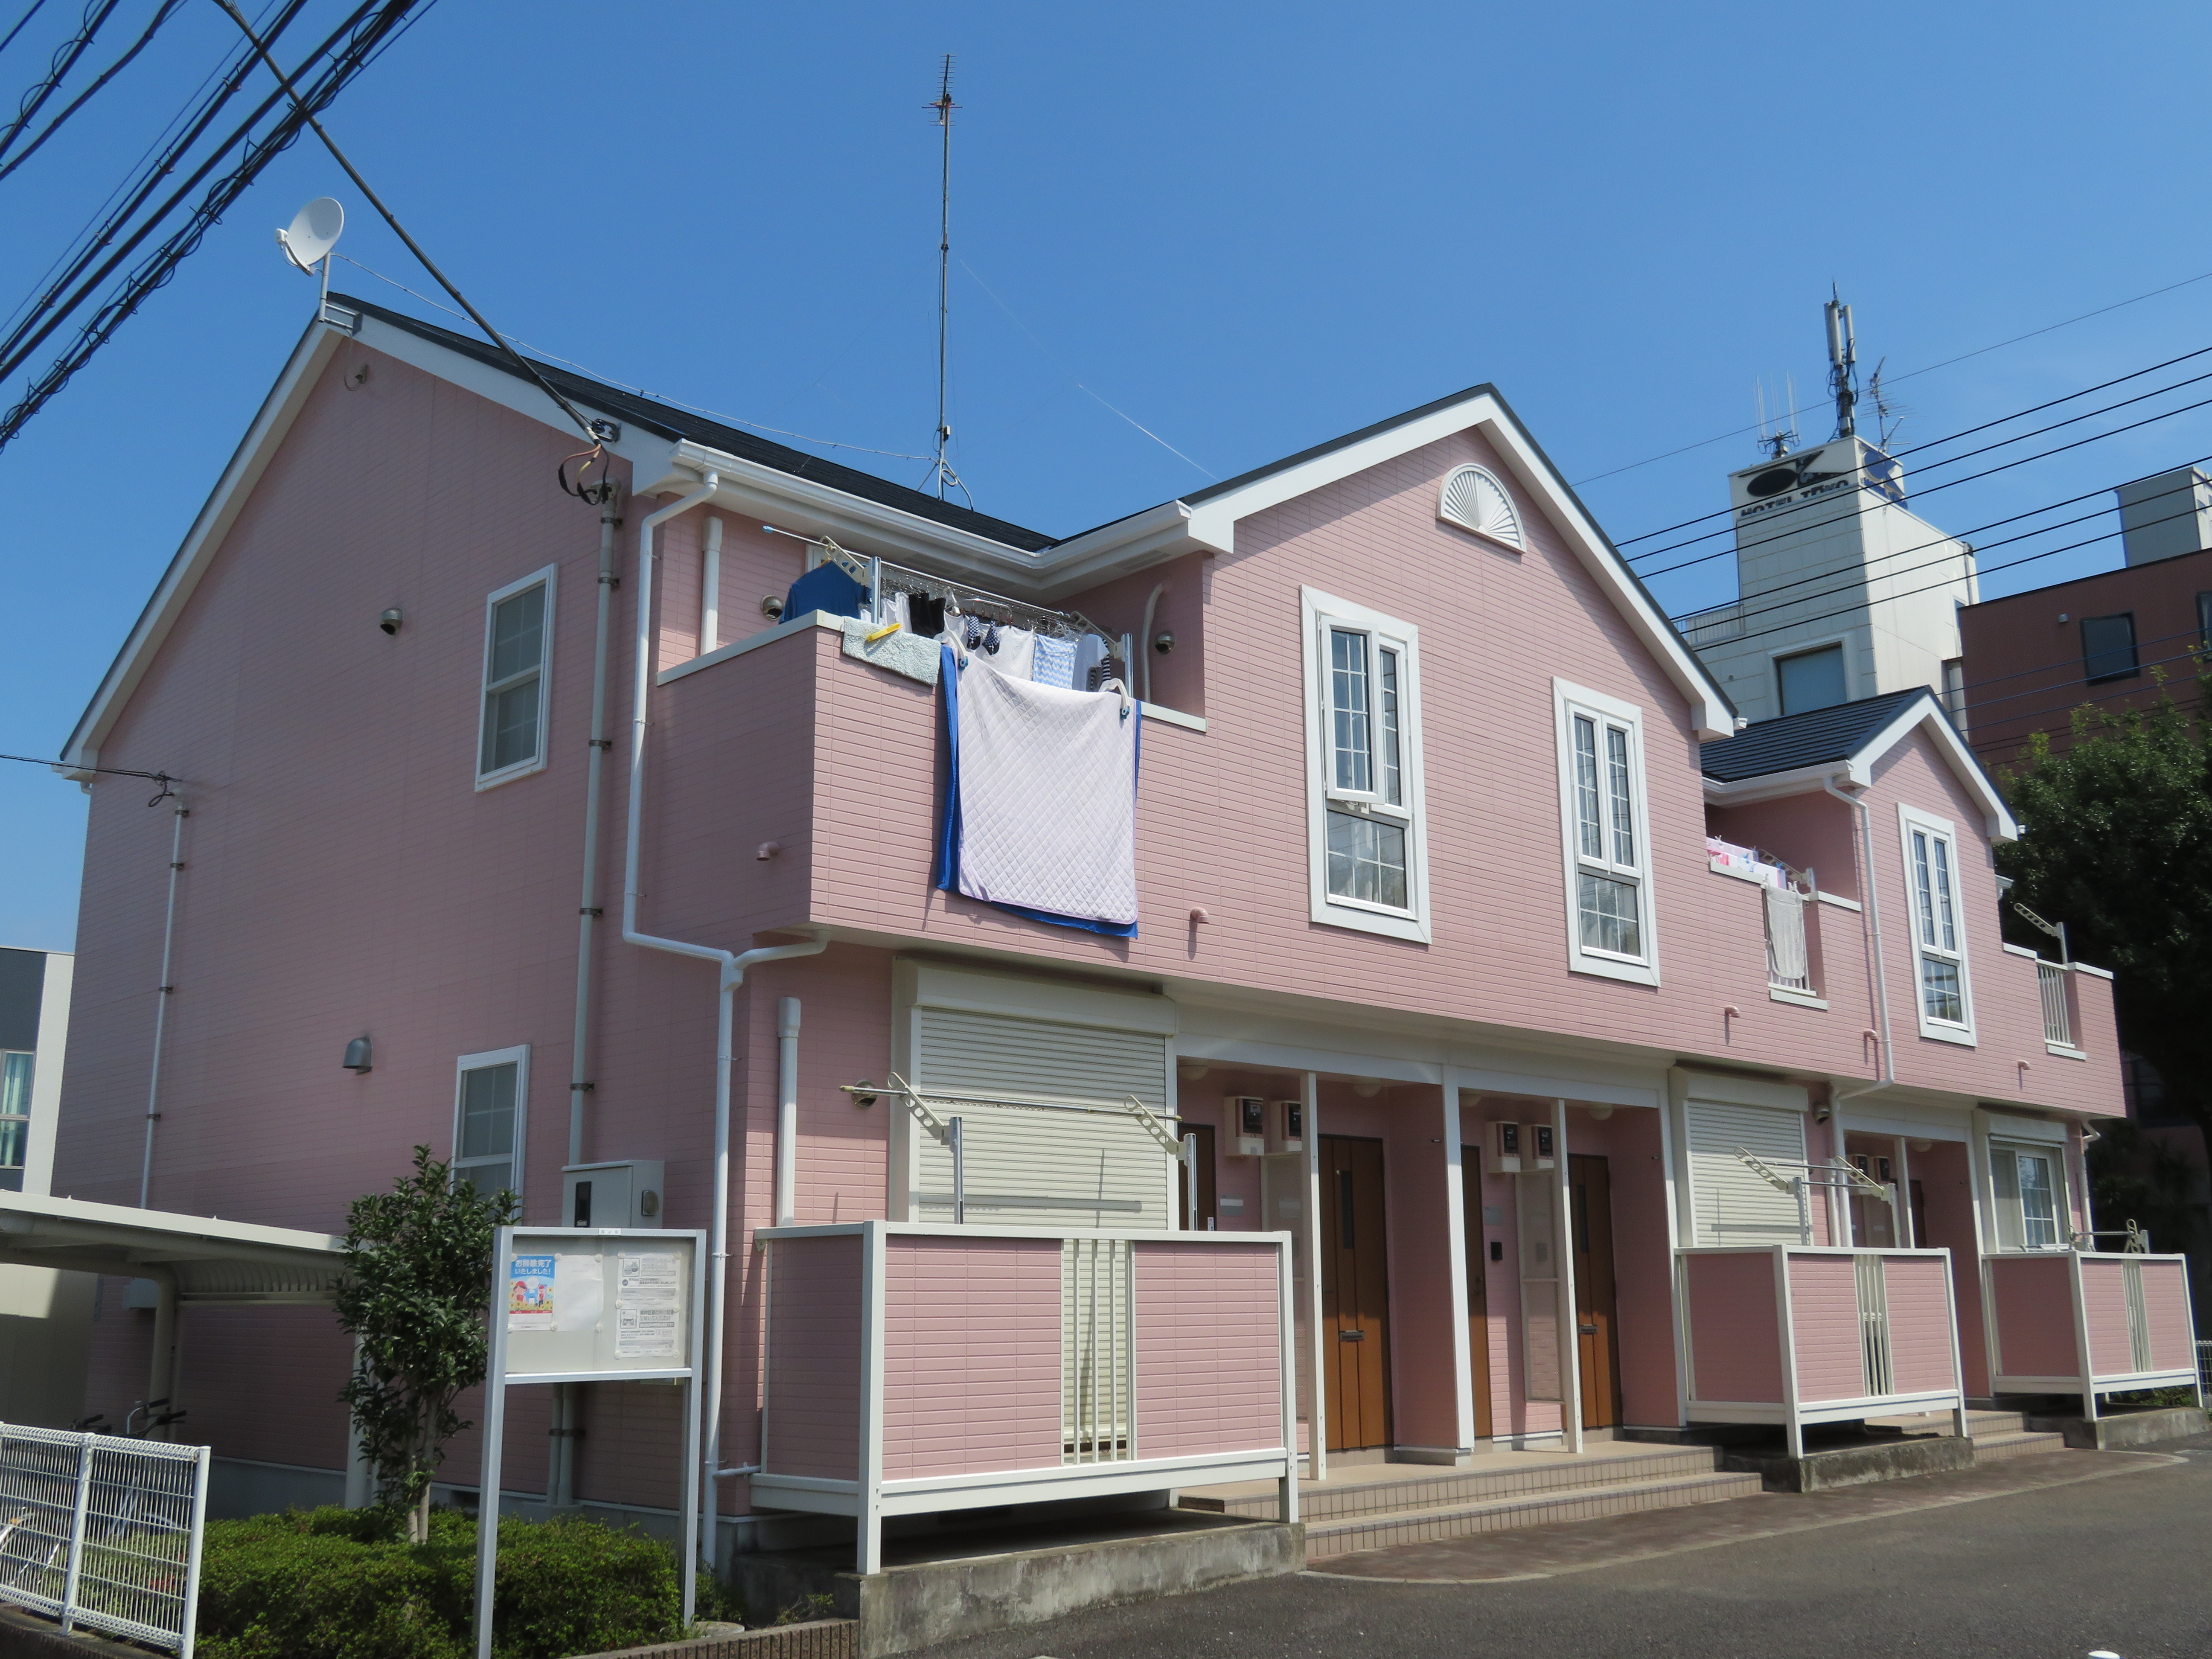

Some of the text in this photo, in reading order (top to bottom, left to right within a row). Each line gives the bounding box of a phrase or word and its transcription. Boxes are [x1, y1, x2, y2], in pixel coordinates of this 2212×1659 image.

[515, 1259, 552, 1267] お掃除完了
